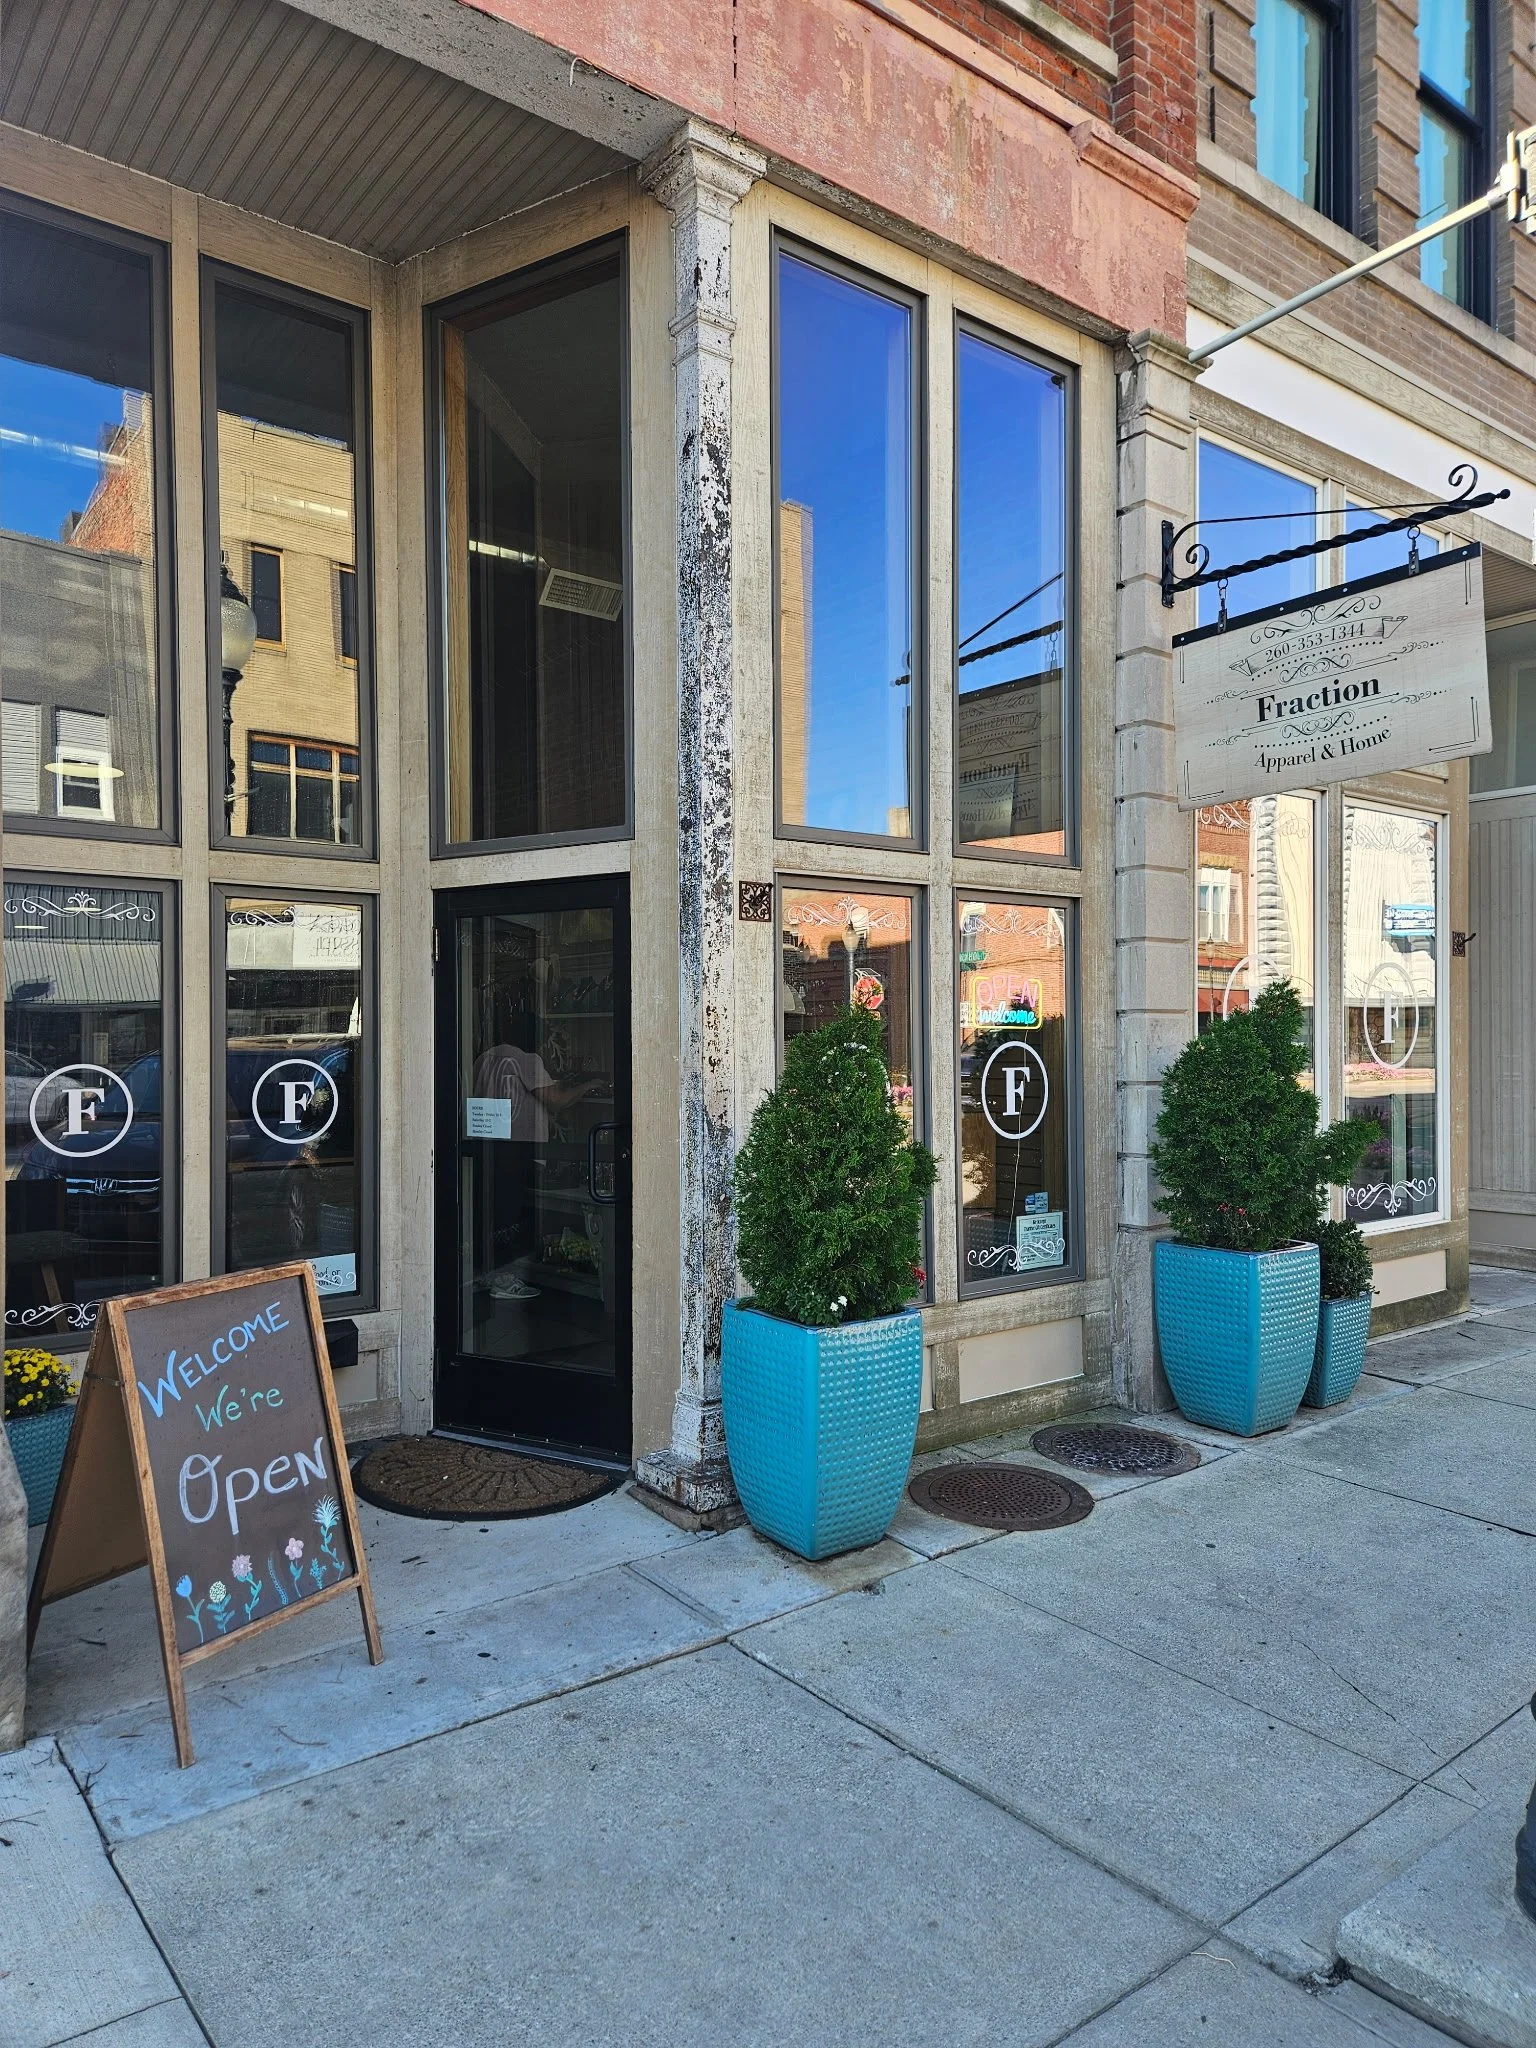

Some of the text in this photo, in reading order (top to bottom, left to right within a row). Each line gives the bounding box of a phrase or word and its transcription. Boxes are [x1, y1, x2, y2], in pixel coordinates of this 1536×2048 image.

[1265, 622, 1365, 663] 260-353-1344
[1256, 678, 1381, 723] Fraction
[1254, 728, 1392, 773] Apparel & Home
[978, 974, 1039, 1009] OPEN
[978, 1001, 1037, 1025] welcome
[1381, 991, 1404, 1044] F
[62, 1088, 105, 1137] F
[279, 1081, 316, 1125] F
[1002, 1066, 1030, 1117] F
[138, 1301, 290, 1418] WELCOME
[195, 1384, 284, 1433] We're
